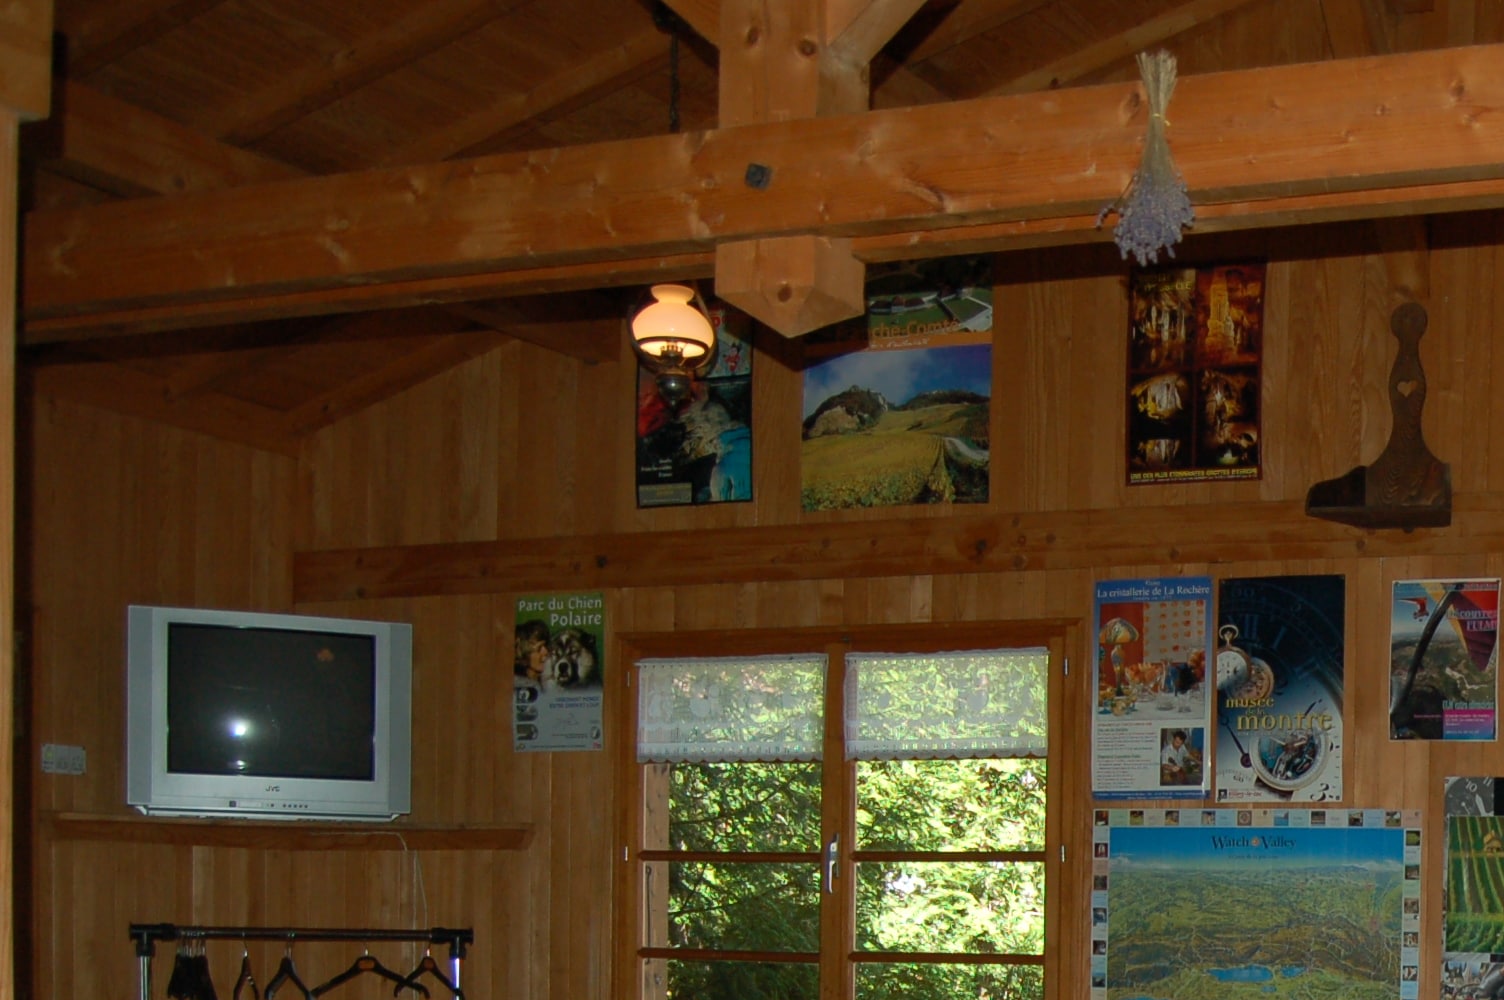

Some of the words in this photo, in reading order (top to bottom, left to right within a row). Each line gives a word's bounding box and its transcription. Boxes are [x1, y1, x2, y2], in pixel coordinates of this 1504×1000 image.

[1097, 589, 1108, 598] La
[1109, 587, 1150, 598] cristallerie
[1152, 588, 1162, 596] de
[1164, 586, 1175, 595] La
[519, 599, 544, 612] Parc
[548, 597, 563, 610] du
[568, 597, 602, 609] Chien
[550, 612, 602, 627] Polaire
[1237, 712, 1333, 731] montre
[265, 785, 280, 793] JVC
[1211, 835, 1249, 849] Watch
[1262, 835, 1296, 850] Valley
